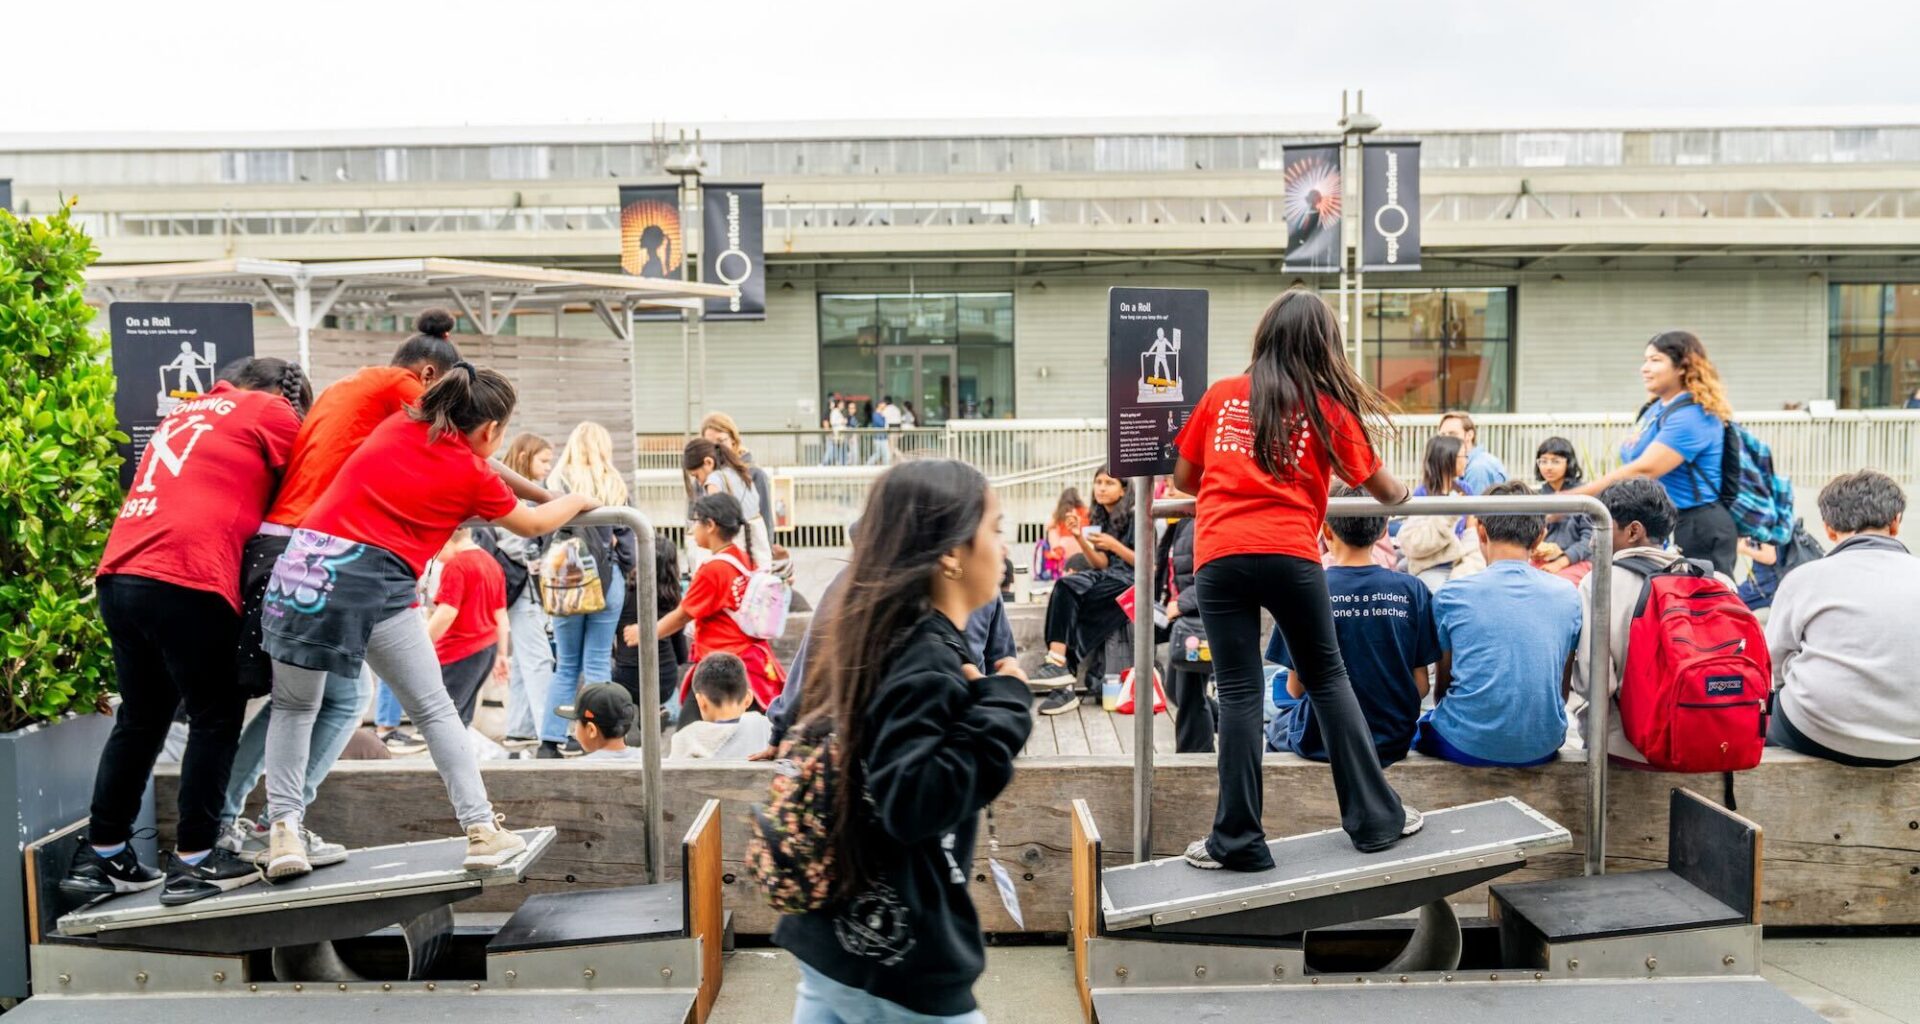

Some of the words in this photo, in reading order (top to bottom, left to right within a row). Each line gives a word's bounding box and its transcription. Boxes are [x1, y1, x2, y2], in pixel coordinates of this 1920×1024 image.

[1120, 302, 1130, 312] On
[1131, 304, 1137, 312] a
[1138, 302, 1151, 312] Roll
[126, 316, 140, 327] On
[142, 319, 149, 327] a
[152, 316, 171, 327] Roll
[119, 497, 158, 518] 1974
[1329, 593, 1360, 603] one's
[1362, 594, 1369, 602] a
[1371, 592, 1409, 604] student.
[1332, 608, 1361, 618] one's
[1362, 609, 1369, 617] a
[1371, 607, 1409, 618] teacher.
